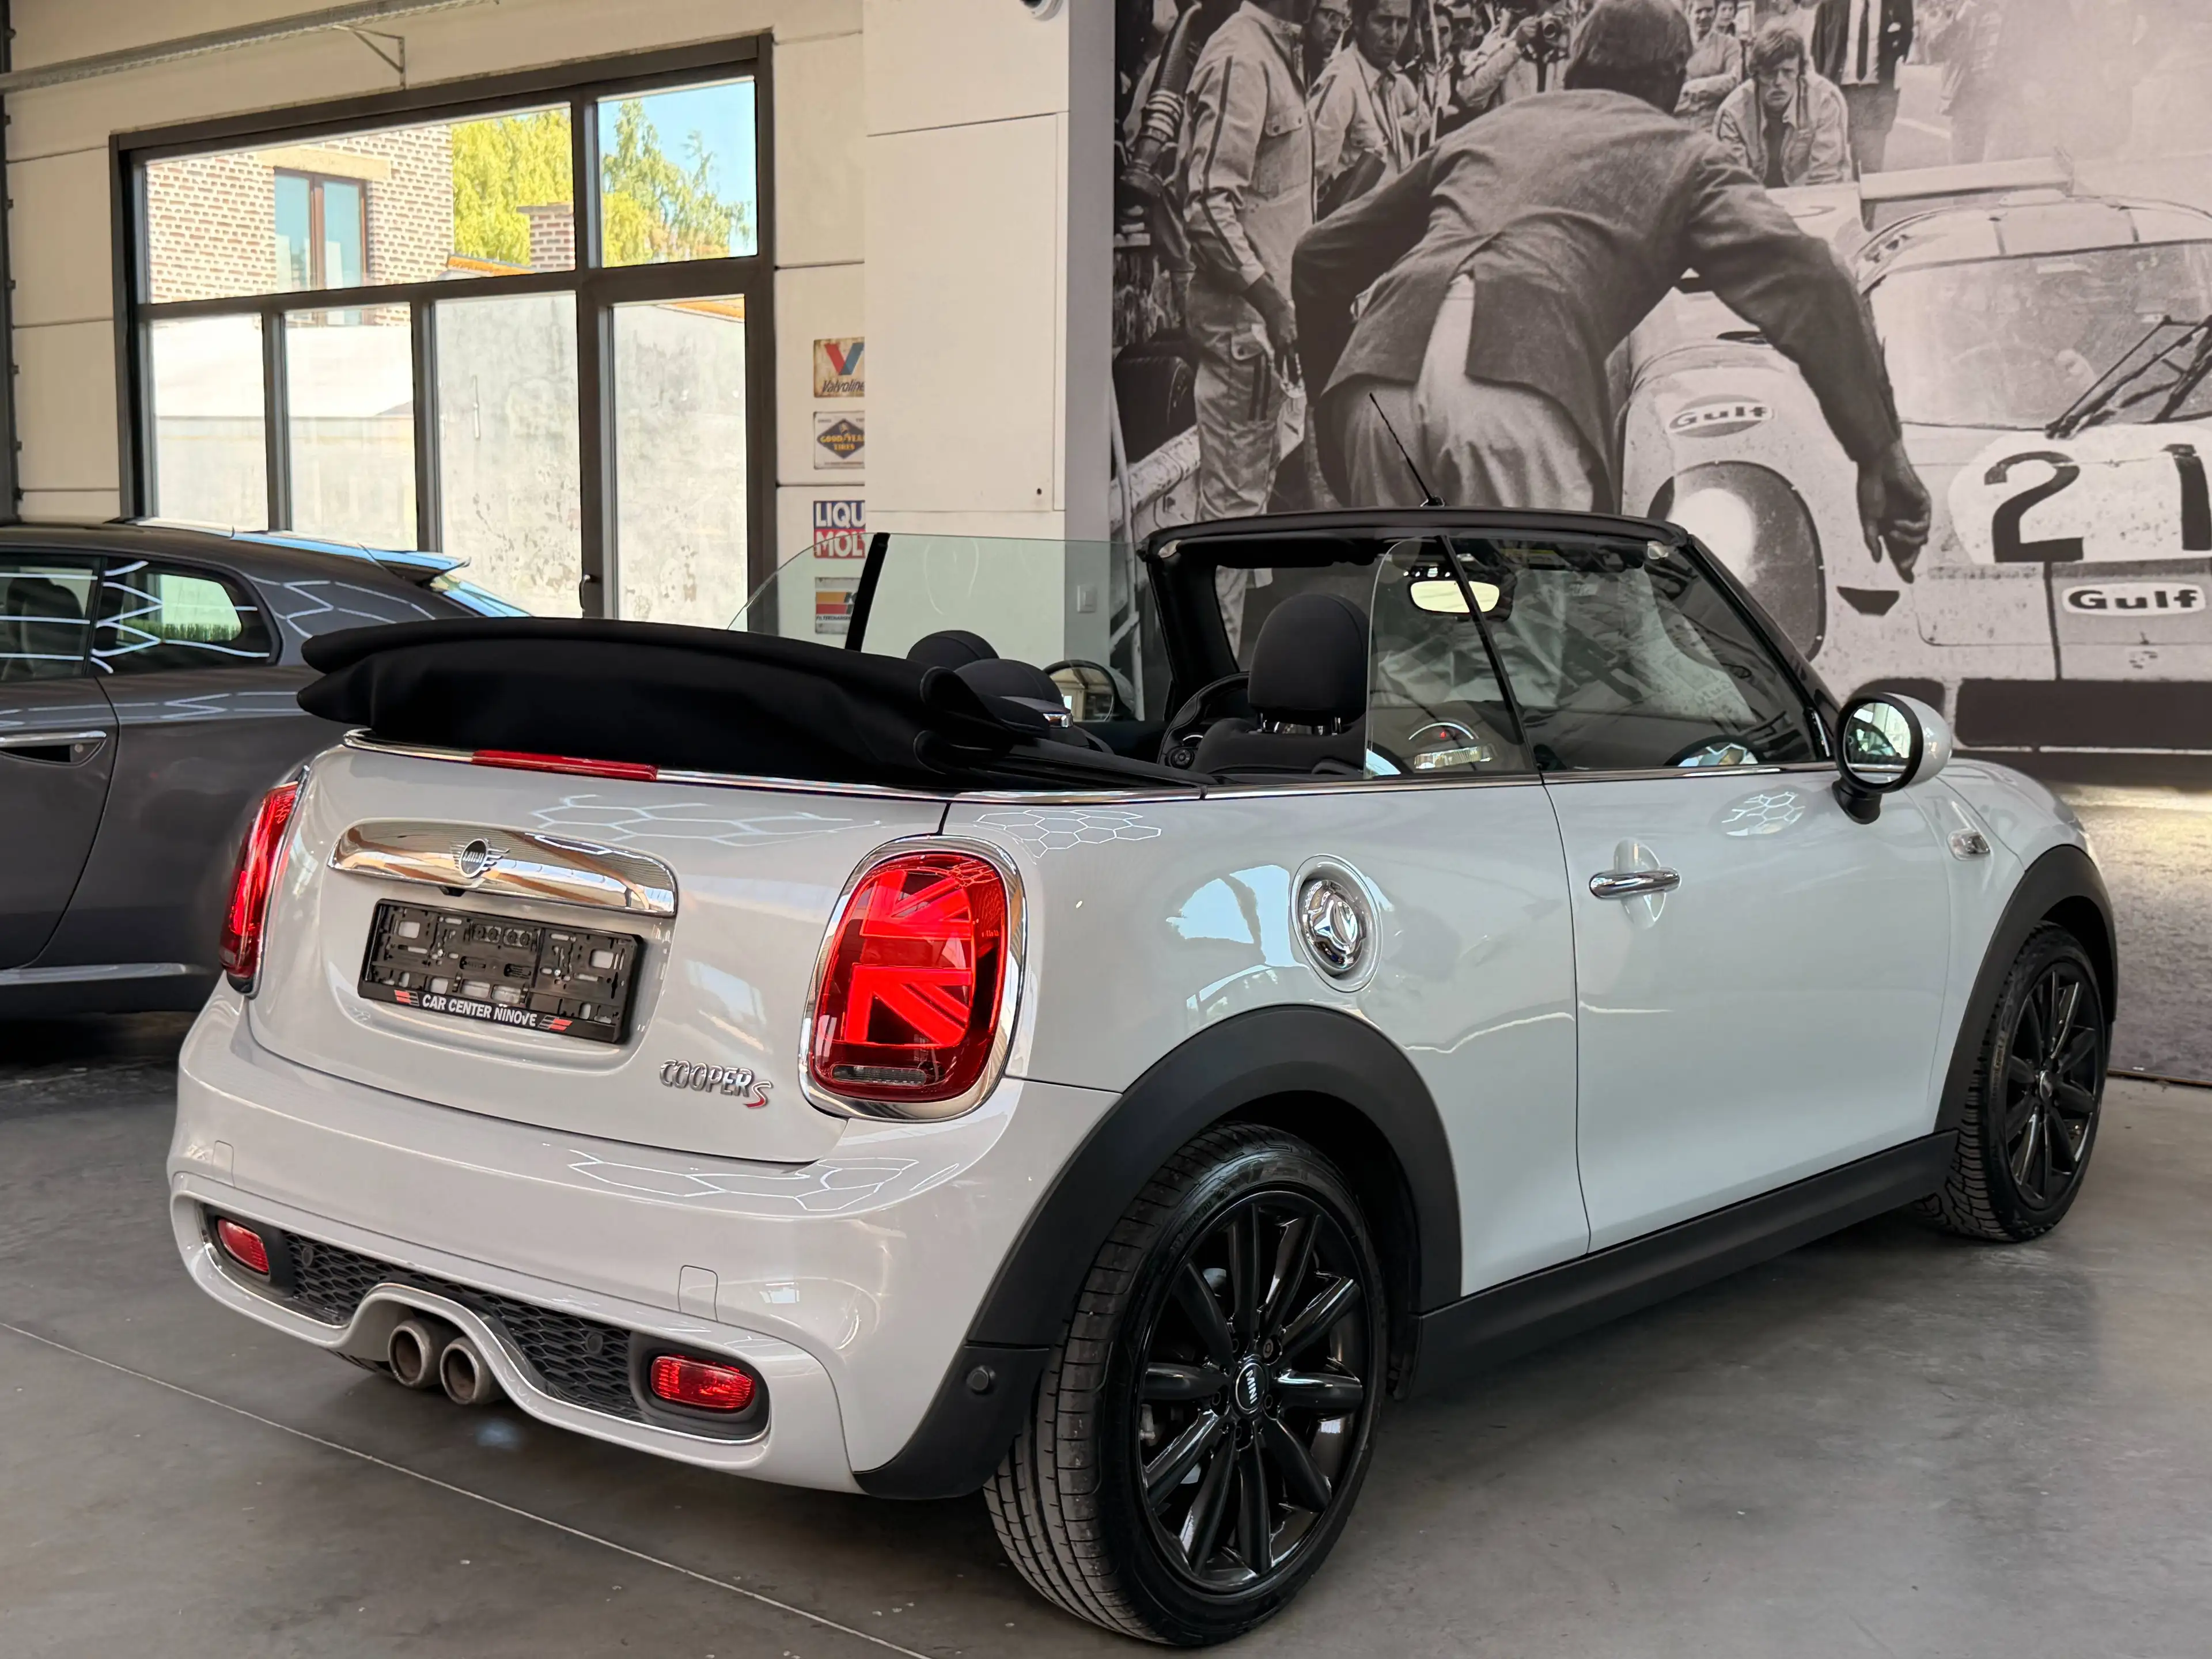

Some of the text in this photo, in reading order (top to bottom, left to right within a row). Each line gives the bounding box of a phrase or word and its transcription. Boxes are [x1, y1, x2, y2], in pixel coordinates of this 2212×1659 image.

[1669, 406, 1767, 429] Gulf
[1984, 444, 2212, 563] 21
[2068, 589, 2198, 609] Gulf
[422, 994, 537, 1027] CAR CENTER NINOVE
[660, 1059, 753, 1097] COOPER
[1245, 1369, 1258, 1404] MINI
